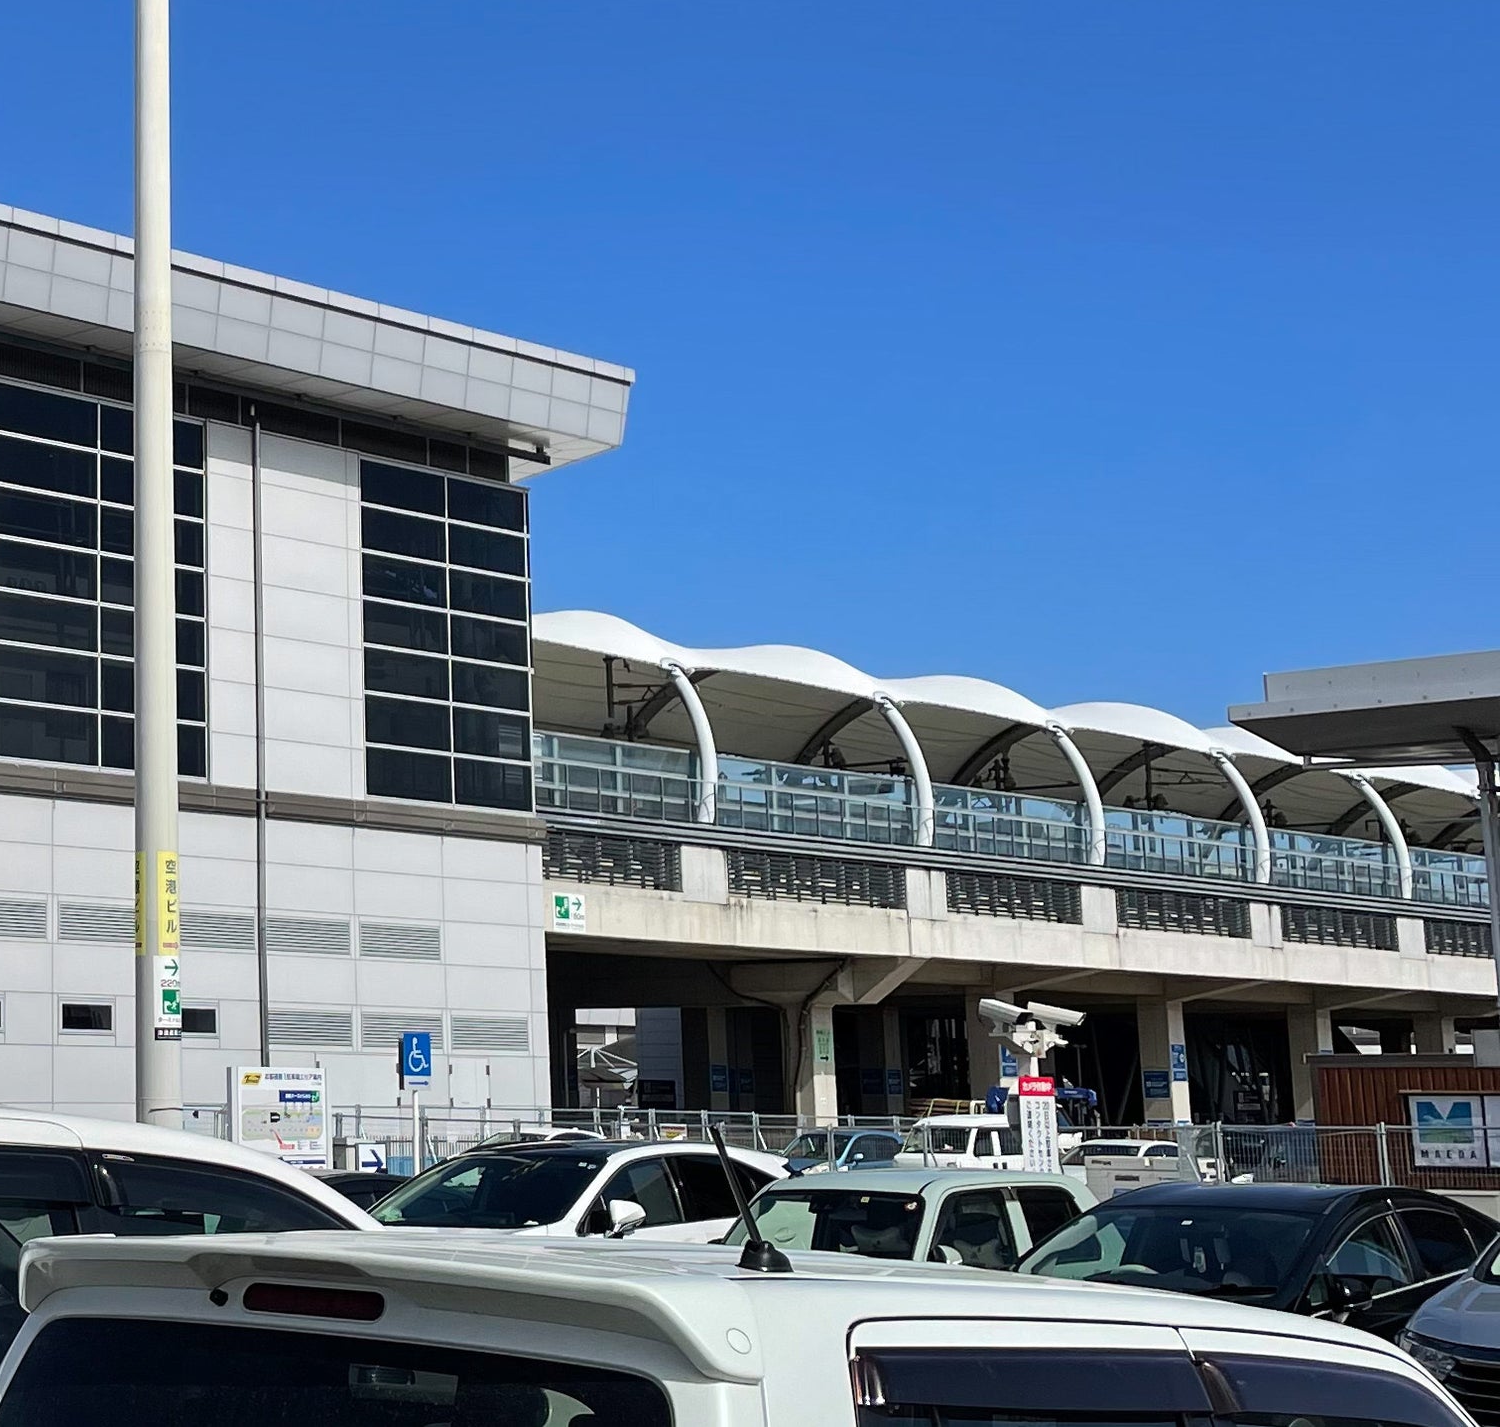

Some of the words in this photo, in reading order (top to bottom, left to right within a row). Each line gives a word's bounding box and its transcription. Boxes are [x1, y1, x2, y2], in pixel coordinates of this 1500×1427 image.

[165, 859, 177, 934] 空港ビル
[1420, 1149, 1477, 1159] MAEDA
